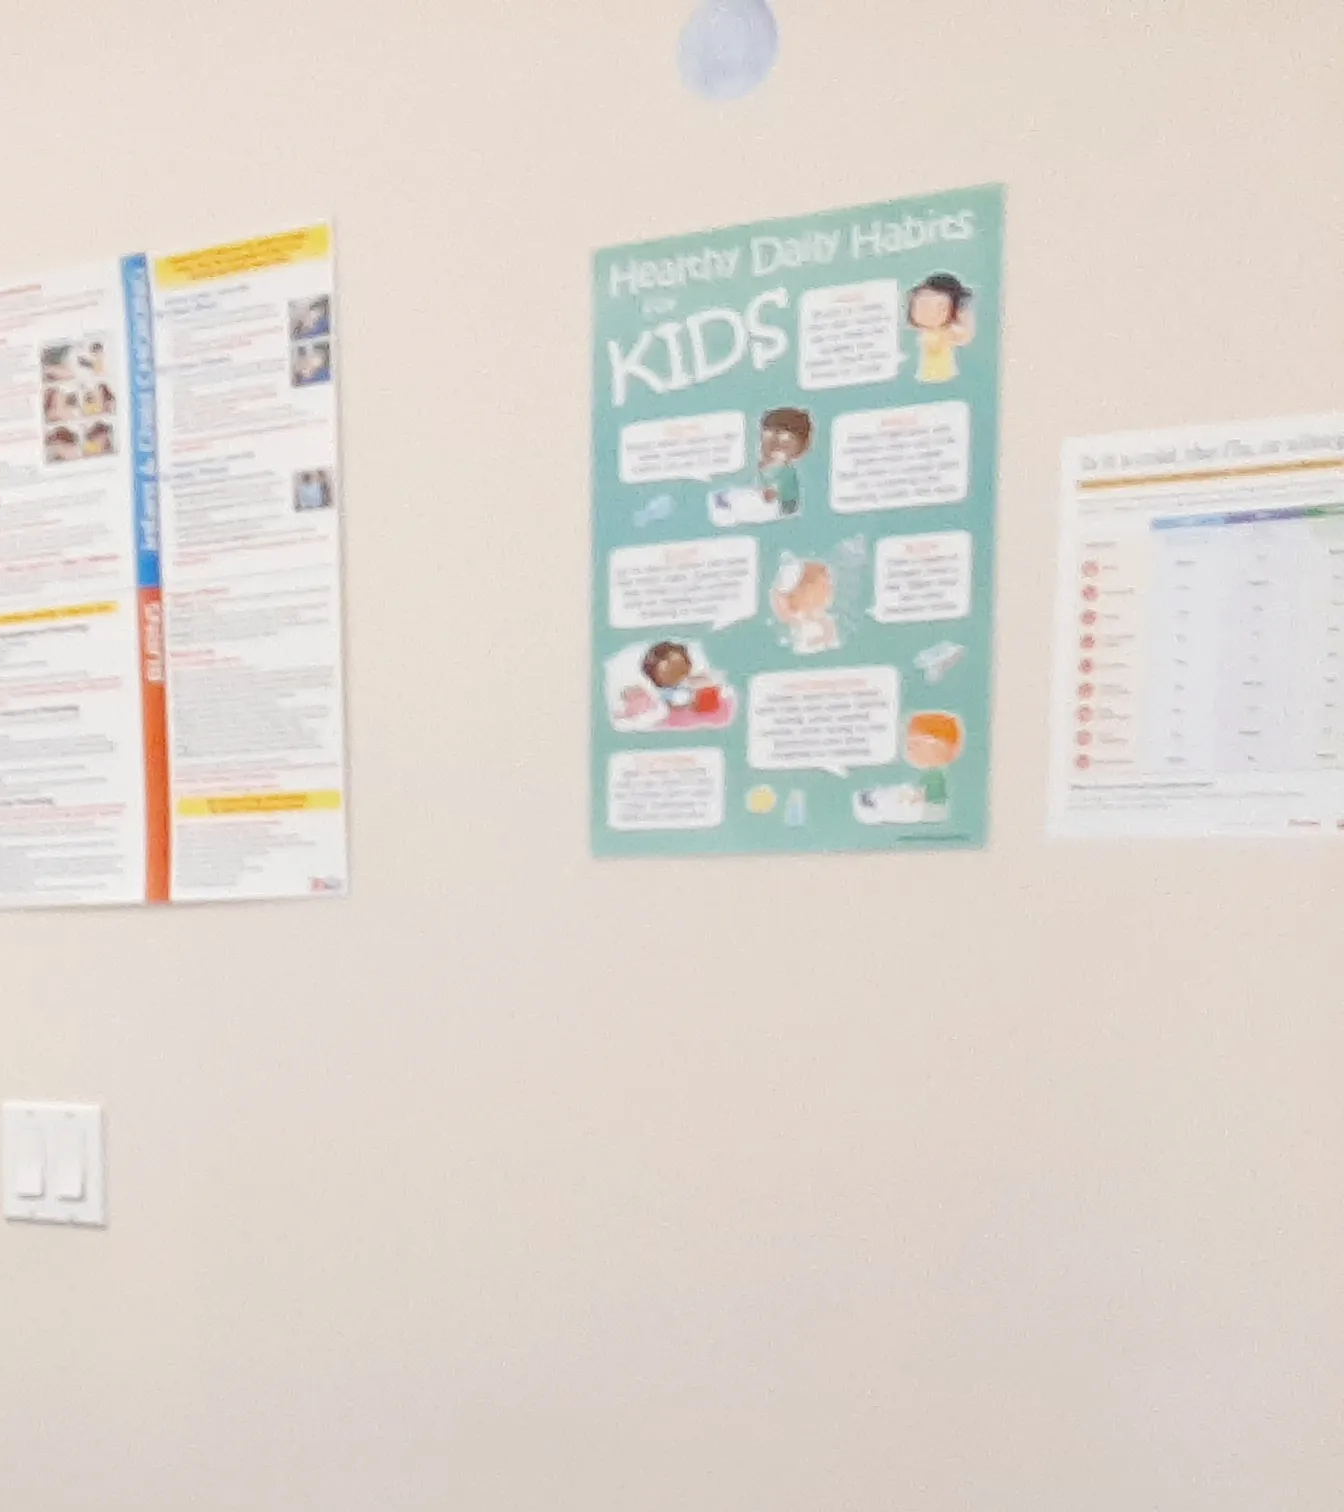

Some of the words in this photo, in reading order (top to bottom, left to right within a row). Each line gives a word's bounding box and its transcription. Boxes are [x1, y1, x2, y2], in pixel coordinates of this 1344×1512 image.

[608, 246, 740, 298] Healthy
[750, 229, 841, 277] Daily
[850, 208, 976, 260] Habits
[608, 286, 789, 406] KIDS
